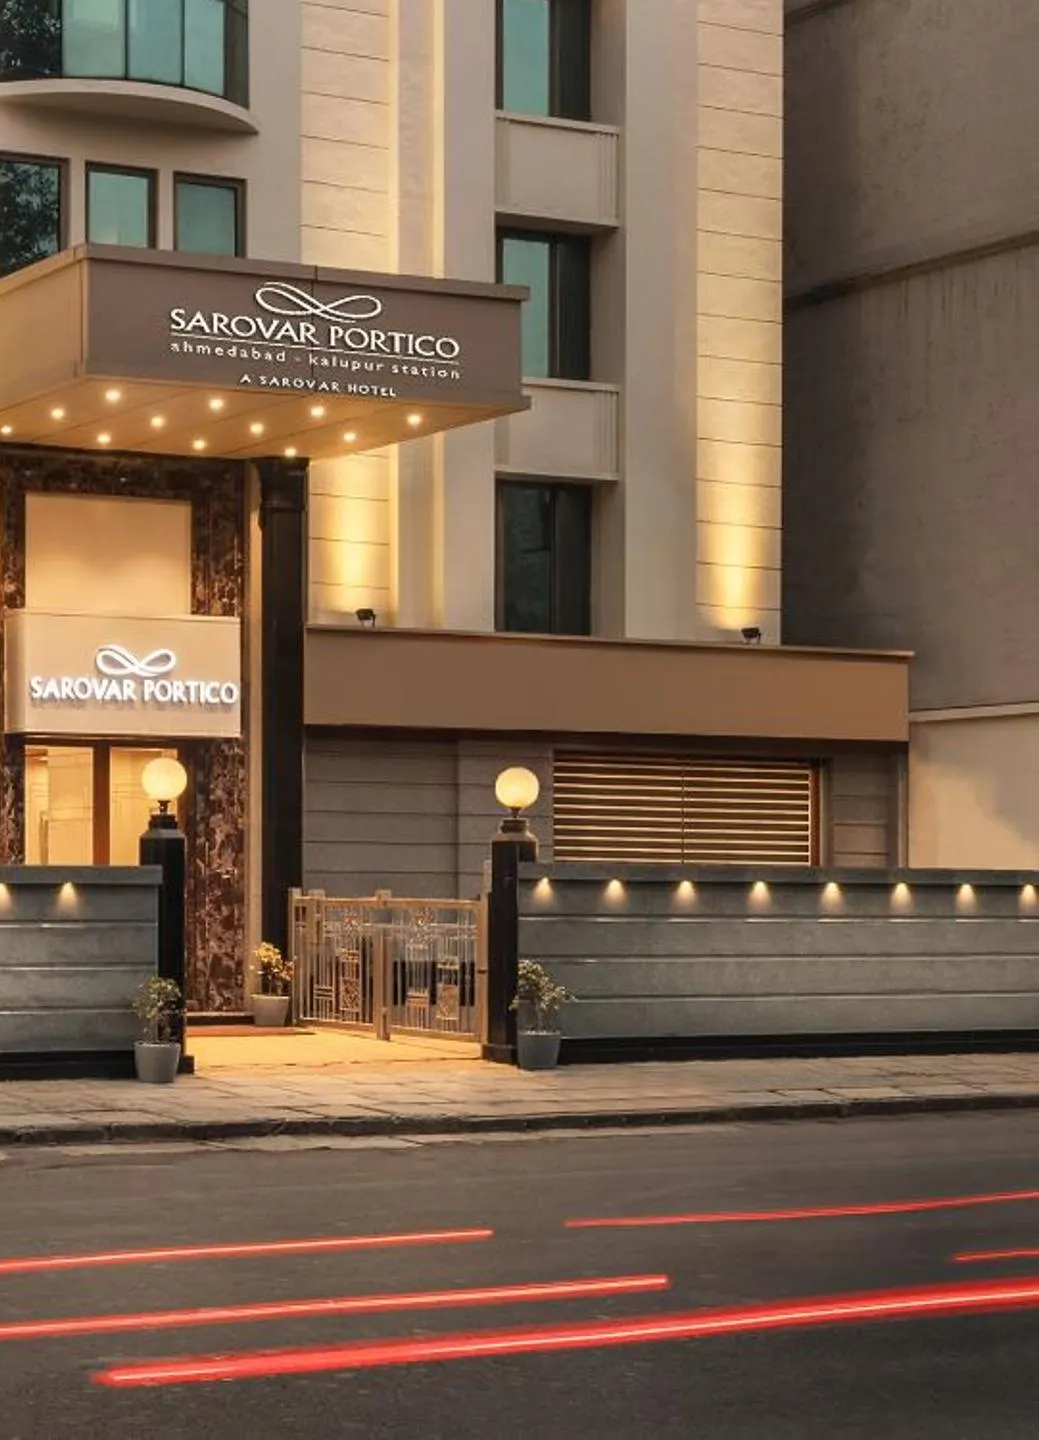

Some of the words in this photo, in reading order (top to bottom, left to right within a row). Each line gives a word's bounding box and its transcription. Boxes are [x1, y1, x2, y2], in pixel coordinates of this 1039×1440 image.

[169, 308, 320, 345] SAROVAR
[329, 326, 460, 359] PORTICO
[170, 341, 286, 363] ahmedabad
[309, 354, 385, 373] kalupur
[391, 362, 460, 380] station
[240, 373, 252, 384] A
[259, 374, 340, 393] SAROVAR
[348, 383, 397, 398] HOTEL
[30, 675, 137, 702] SAROVAR
[144, 679, 239, 704] PORTICO
